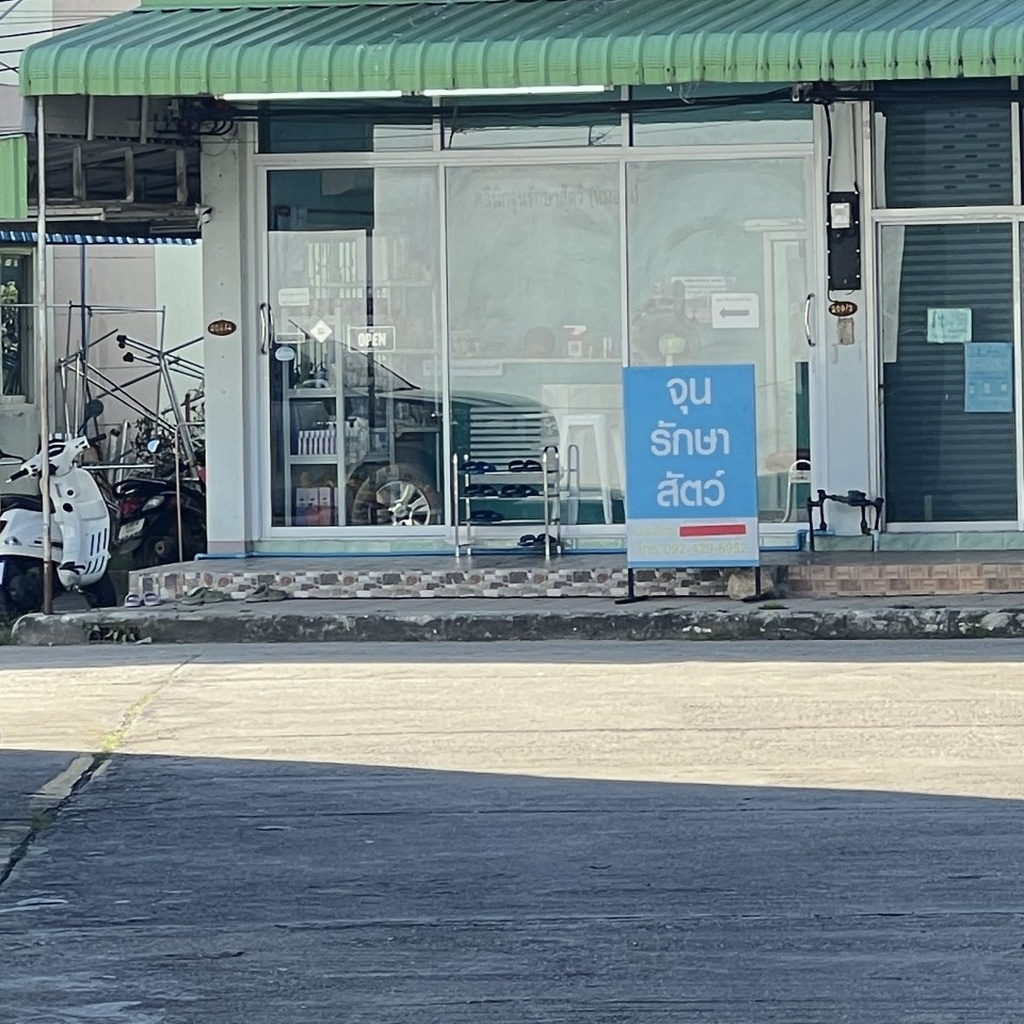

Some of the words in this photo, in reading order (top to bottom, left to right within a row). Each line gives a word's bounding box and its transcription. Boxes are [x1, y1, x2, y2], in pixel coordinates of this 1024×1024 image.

[358, 332, 387, 347] OPEN
[666, 377, 711, 415] จุน
[650, 420, 730, 456] รักษา
[657, 469, 725, 507] สัตว์
